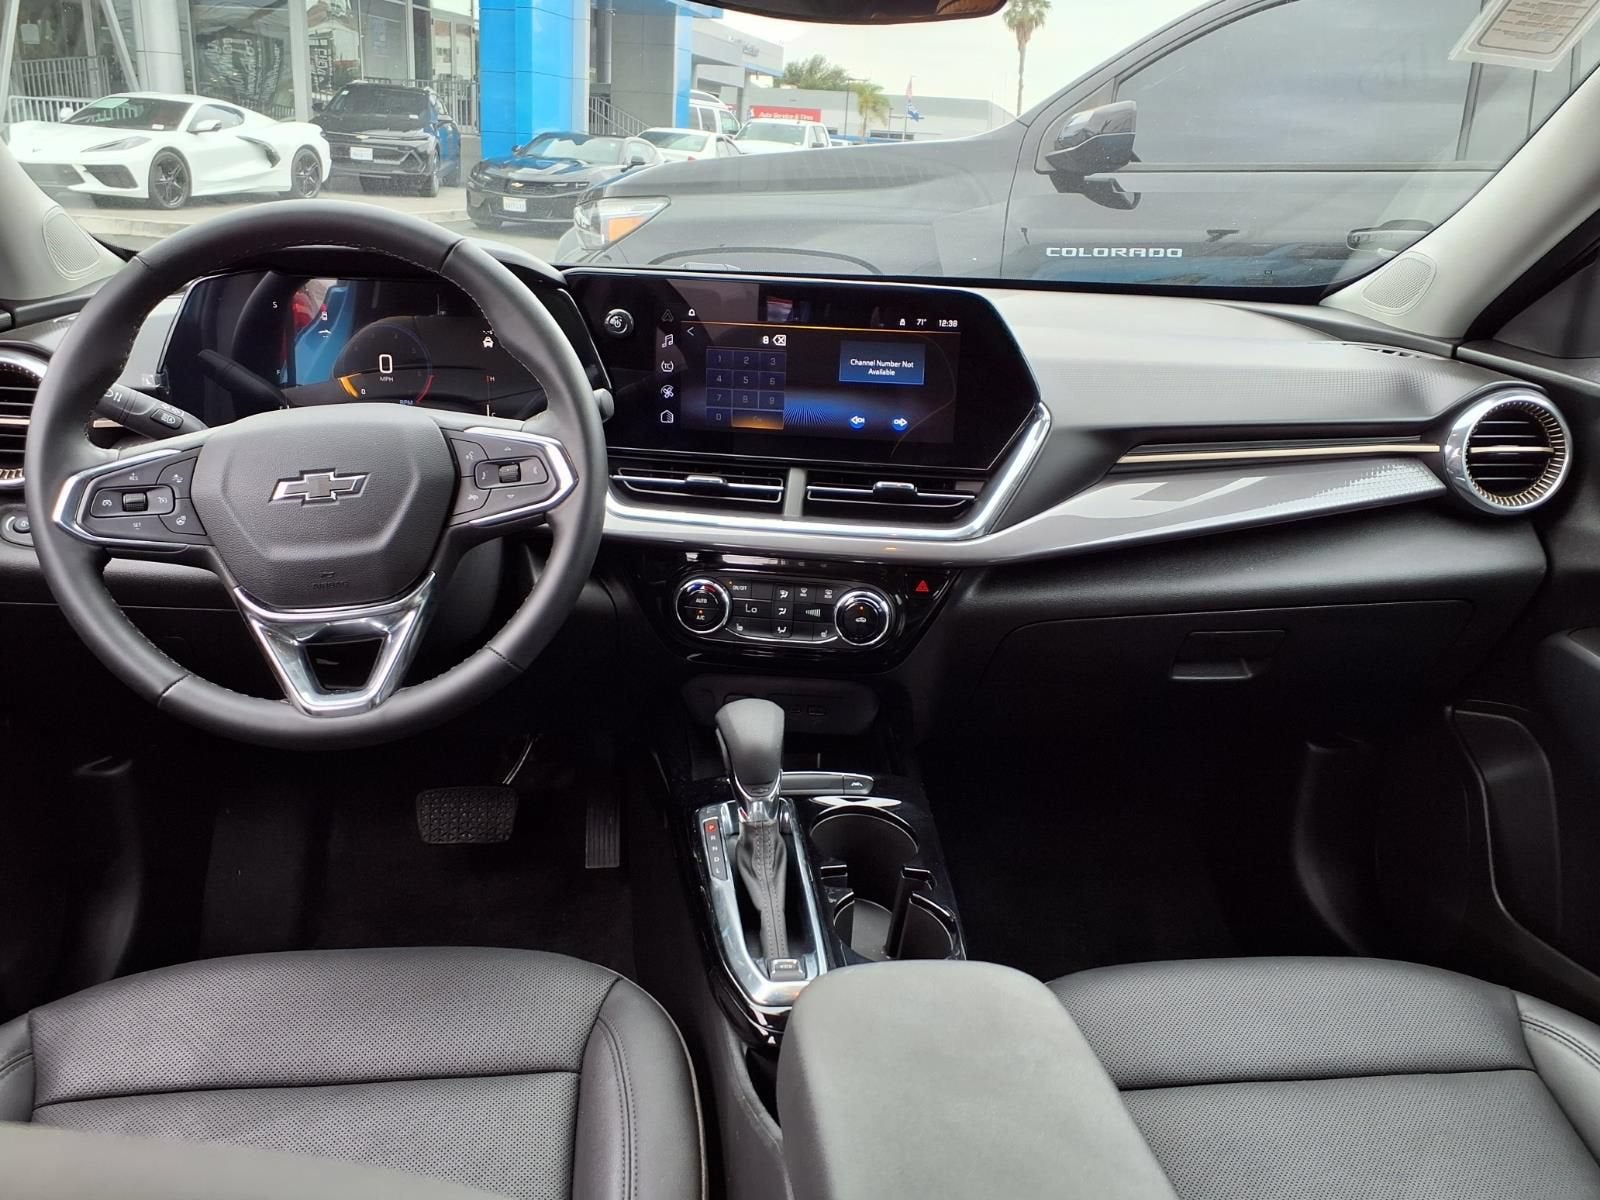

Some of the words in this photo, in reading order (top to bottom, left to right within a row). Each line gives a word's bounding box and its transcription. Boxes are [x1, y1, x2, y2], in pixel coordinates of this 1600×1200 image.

[1045, 247, 1183, 258] COLORADO
[762, 335, 769, 345] 8
[379, 354, 393, 374] 0
[743, 356, 750, 365] 2
[769, 357, 776, 366] 3
[850, 358, 876, 367] Channel
[876, 360, 901, 369] Number
[902, 361, 914, 369] Not
[868, 368, 895, 377] Available
[716, 375, 722, 383] 4
[743, 376, 749, 384] 5
